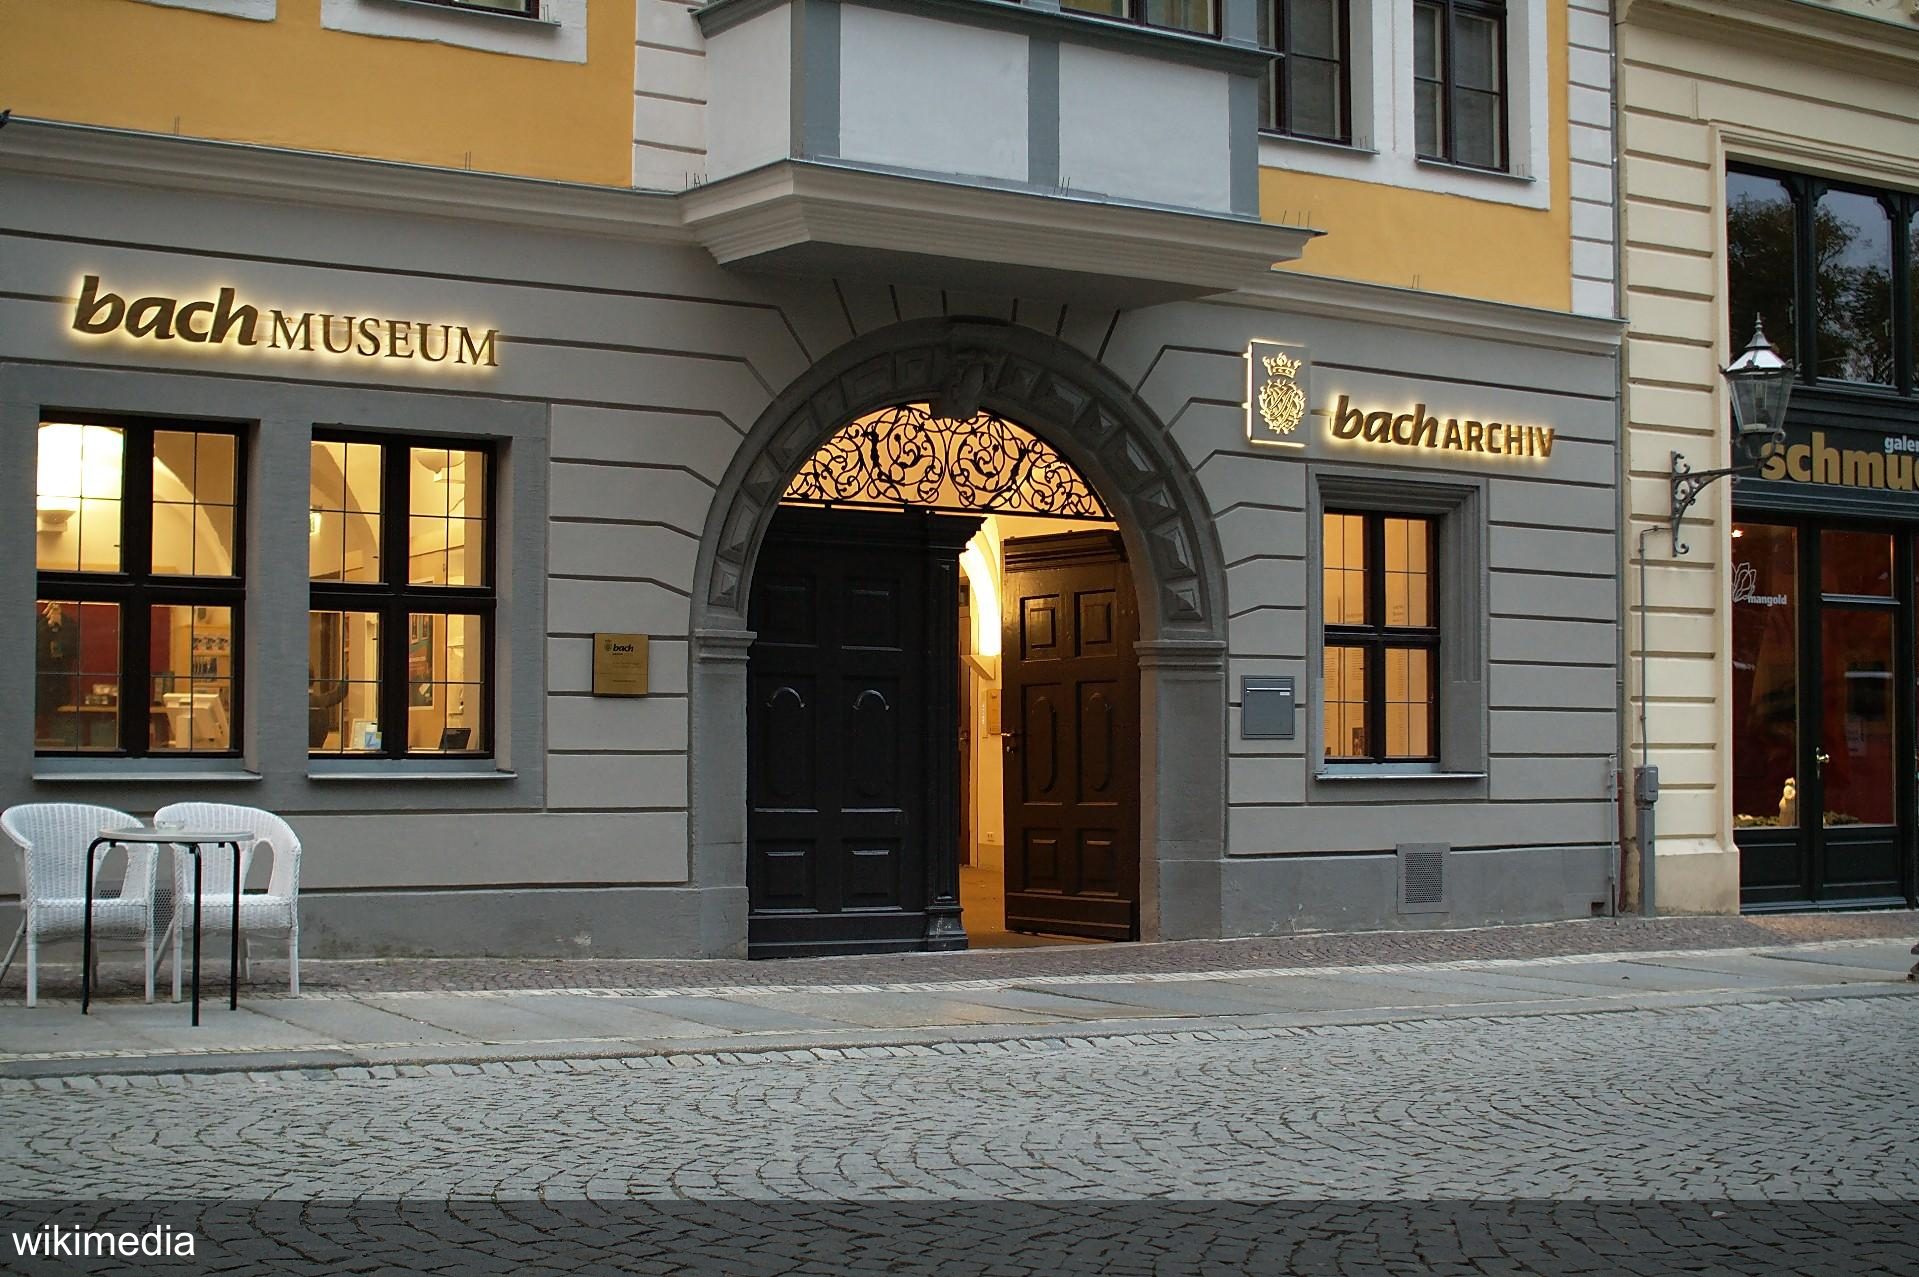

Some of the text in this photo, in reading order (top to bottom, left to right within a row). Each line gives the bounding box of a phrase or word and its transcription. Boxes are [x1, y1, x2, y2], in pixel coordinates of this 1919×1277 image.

[1761, 431, 1919, 491] schmu
[1747, 594, 1787, 607] mangold
[613, 644, 634, 652] bach
